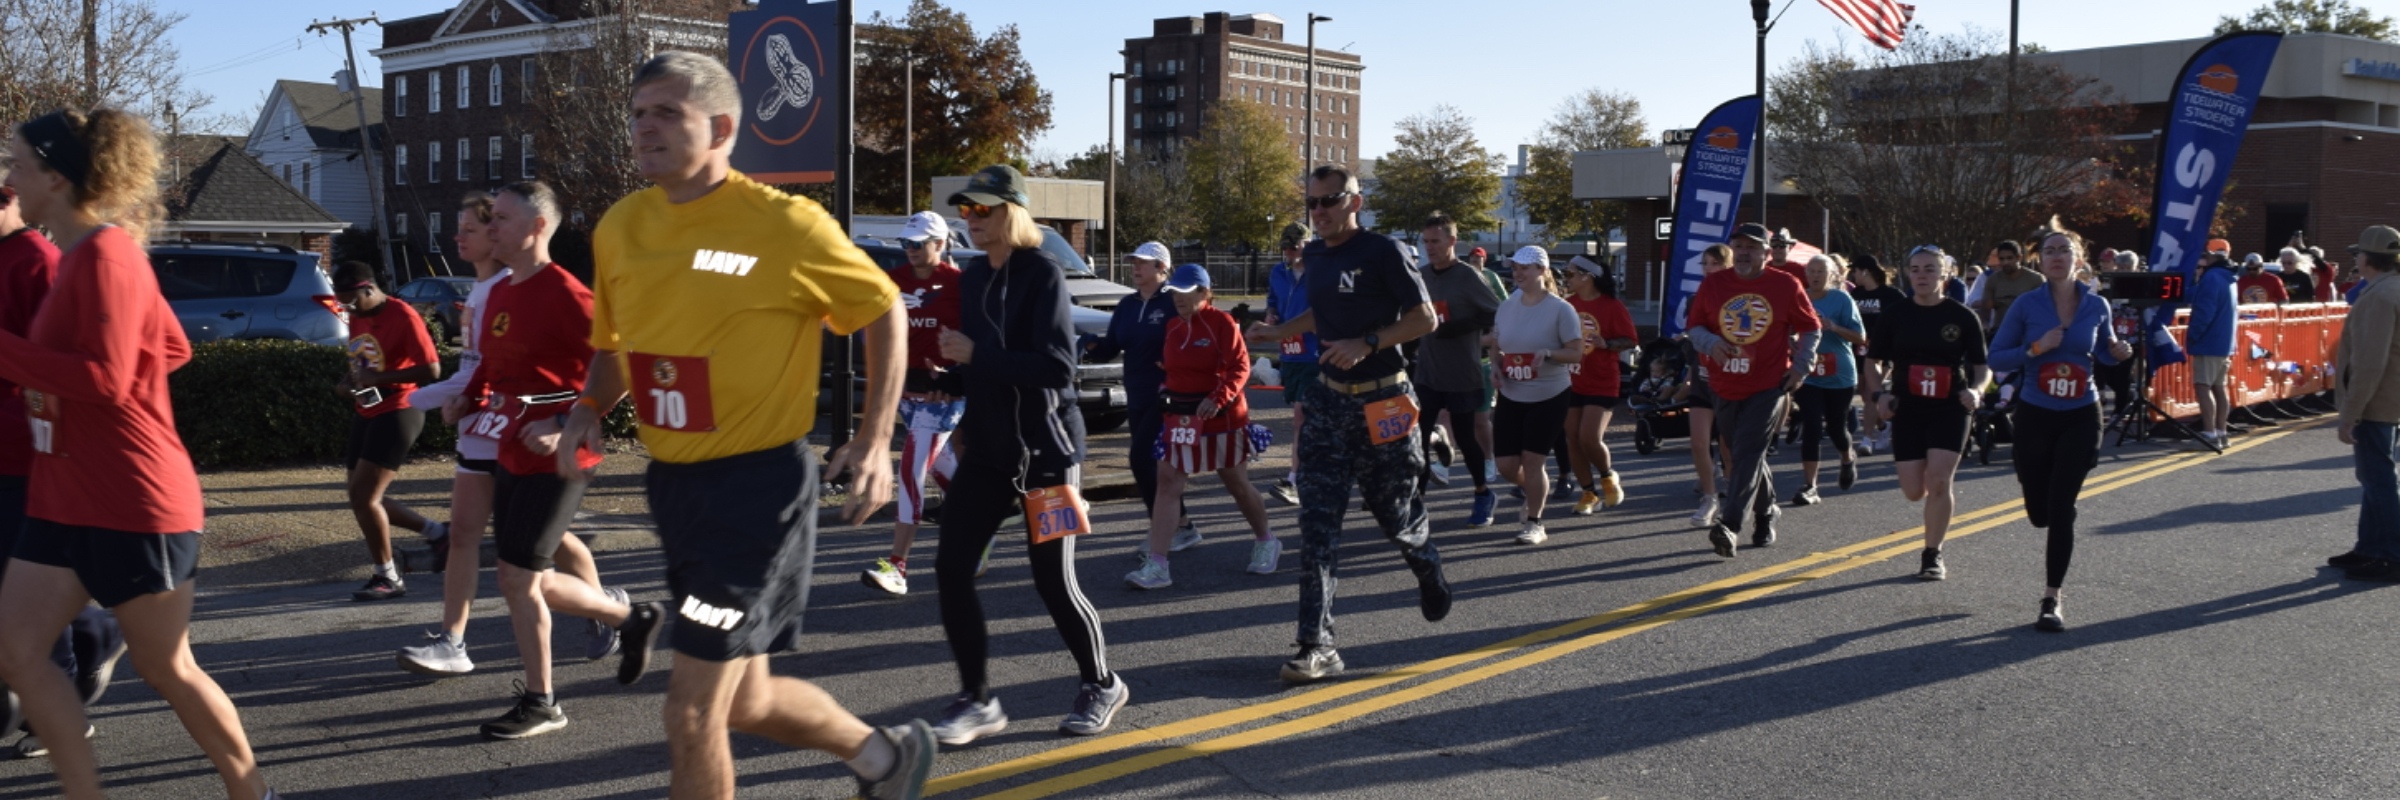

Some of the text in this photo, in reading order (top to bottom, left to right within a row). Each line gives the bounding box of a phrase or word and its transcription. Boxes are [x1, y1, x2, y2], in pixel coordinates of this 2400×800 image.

[2183, 92, 2247, 118] TIDEWATER
[2185, 106, 2236, 128] STRIDERS
[1696, 150, 1748, 166] TIDEWATER
[1697, 161, 1742, 176] STRIDERS
[692, 248, 759, 277] NAVY
[2161, 276, 2183, 299] 37
[1506, 365, 1532, 380] 200
[1920, 379, 1937, 396] 11
[2048, 377, 2078, 398] 191
[649, 387, 687, 429] 70
[1169, 427, 1197, 445] 133
[1036, 505, 1079, 536] 370
[679, 594, 745, 631] NAVY
